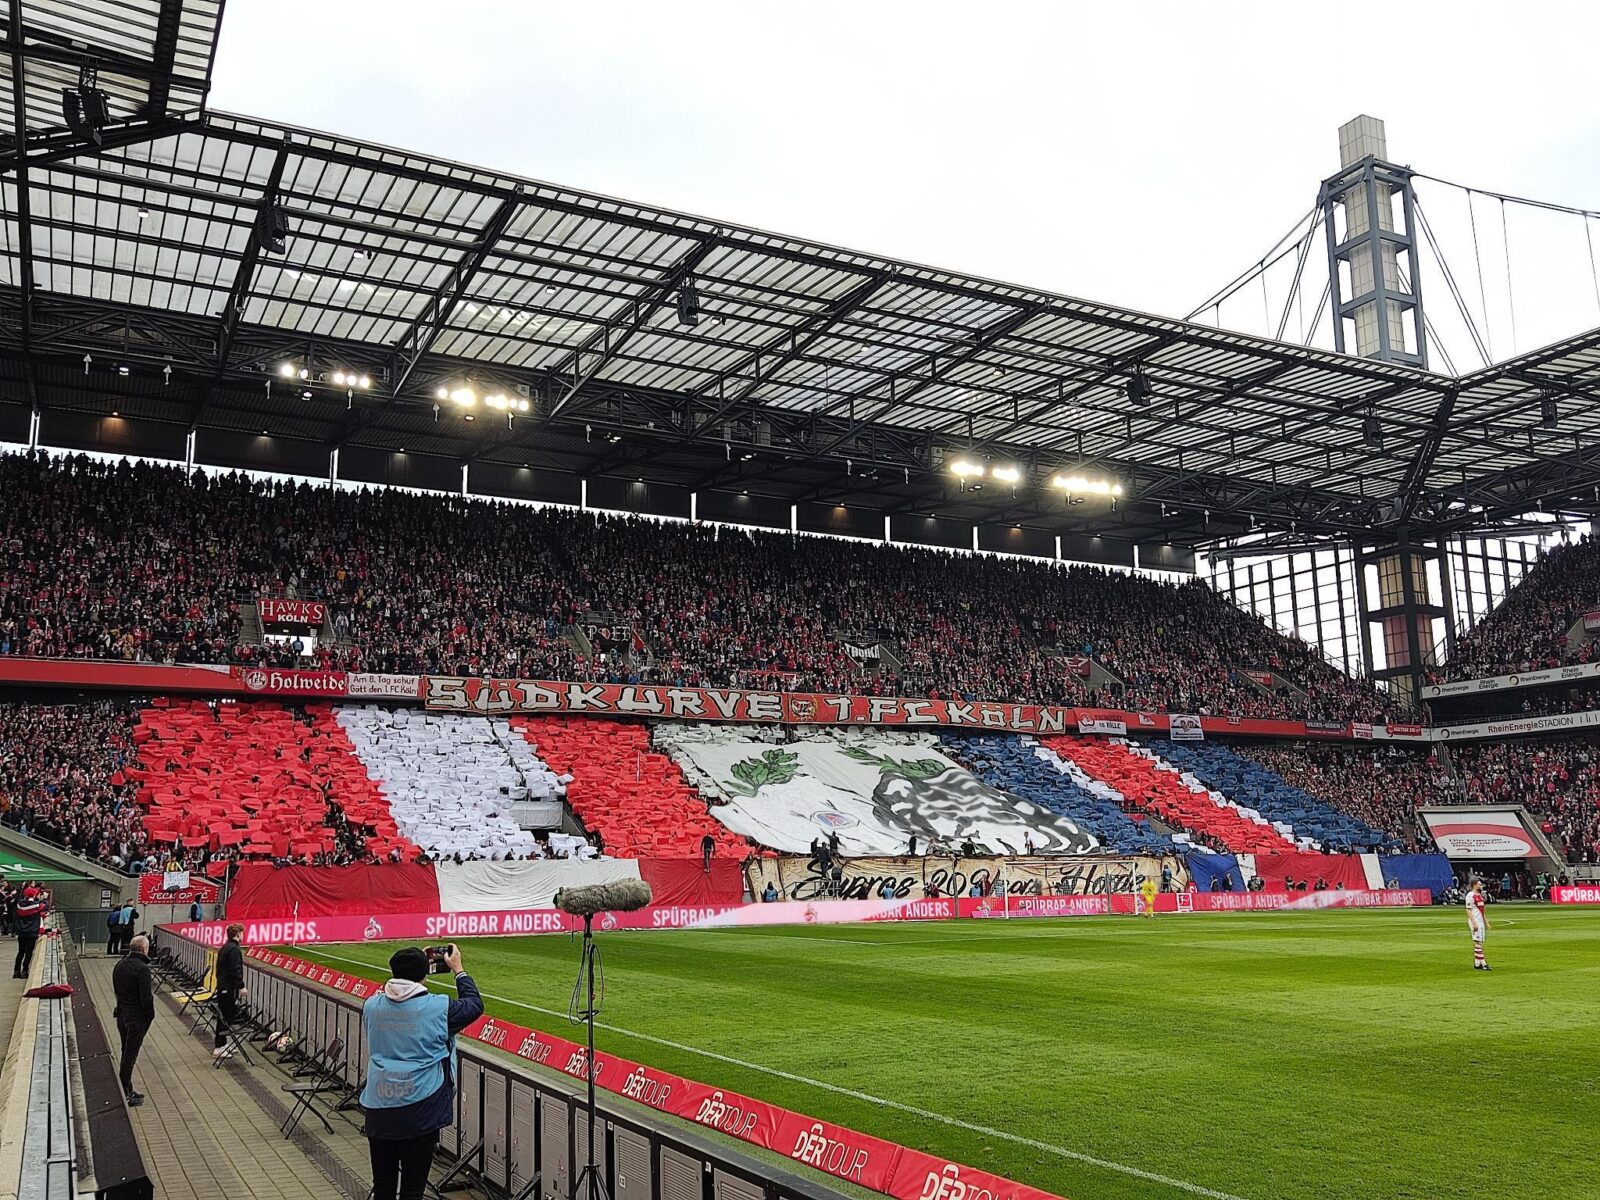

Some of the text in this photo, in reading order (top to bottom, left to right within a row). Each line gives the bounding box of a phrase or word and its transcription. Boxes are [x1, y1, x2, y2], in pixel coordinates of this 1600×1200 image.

[260, 600, 323, 620] HAWKS
[277, 612, 308, 624] KÖLN
[844, 643, 881, 659] TROIKA
[270, 672, 345, 692] Holweide
[353, 675, 415, 685] Am 8. Tag schuf
[1521, 674, 1551, 683] RheinEnergie
[1561, 671, 1583, 679] Energie
[350, 685, 367, 693] Gott
[368, 685, 382, 693] den
[400, 685, 416, 694] Köln
[1442, 685, 1469, 693] RheinEnergie
[426, 677, 784, 719] SÜDKURVE
[824, 696, 940, 724] 1.FC
[946, 702, 1065, 732] KÖLN
[1451, 728, 1479, 736] RheinEnergie
[1488, 717, 1574, 734] RheinEnergieSTADION
[929, 868, 967, 897] 20
[149, 892, 177, 900] JECK
[179, 892, 193, 900] OP
[1211, 892, 1253, 909] SPÜRBAR
[906, 902, 953, 918] ANDERS.
[426, 913, 565, 935] SPÜRBAR ANDERS.
[180, 922, 321, 945] SPÜRB ANDERS.
